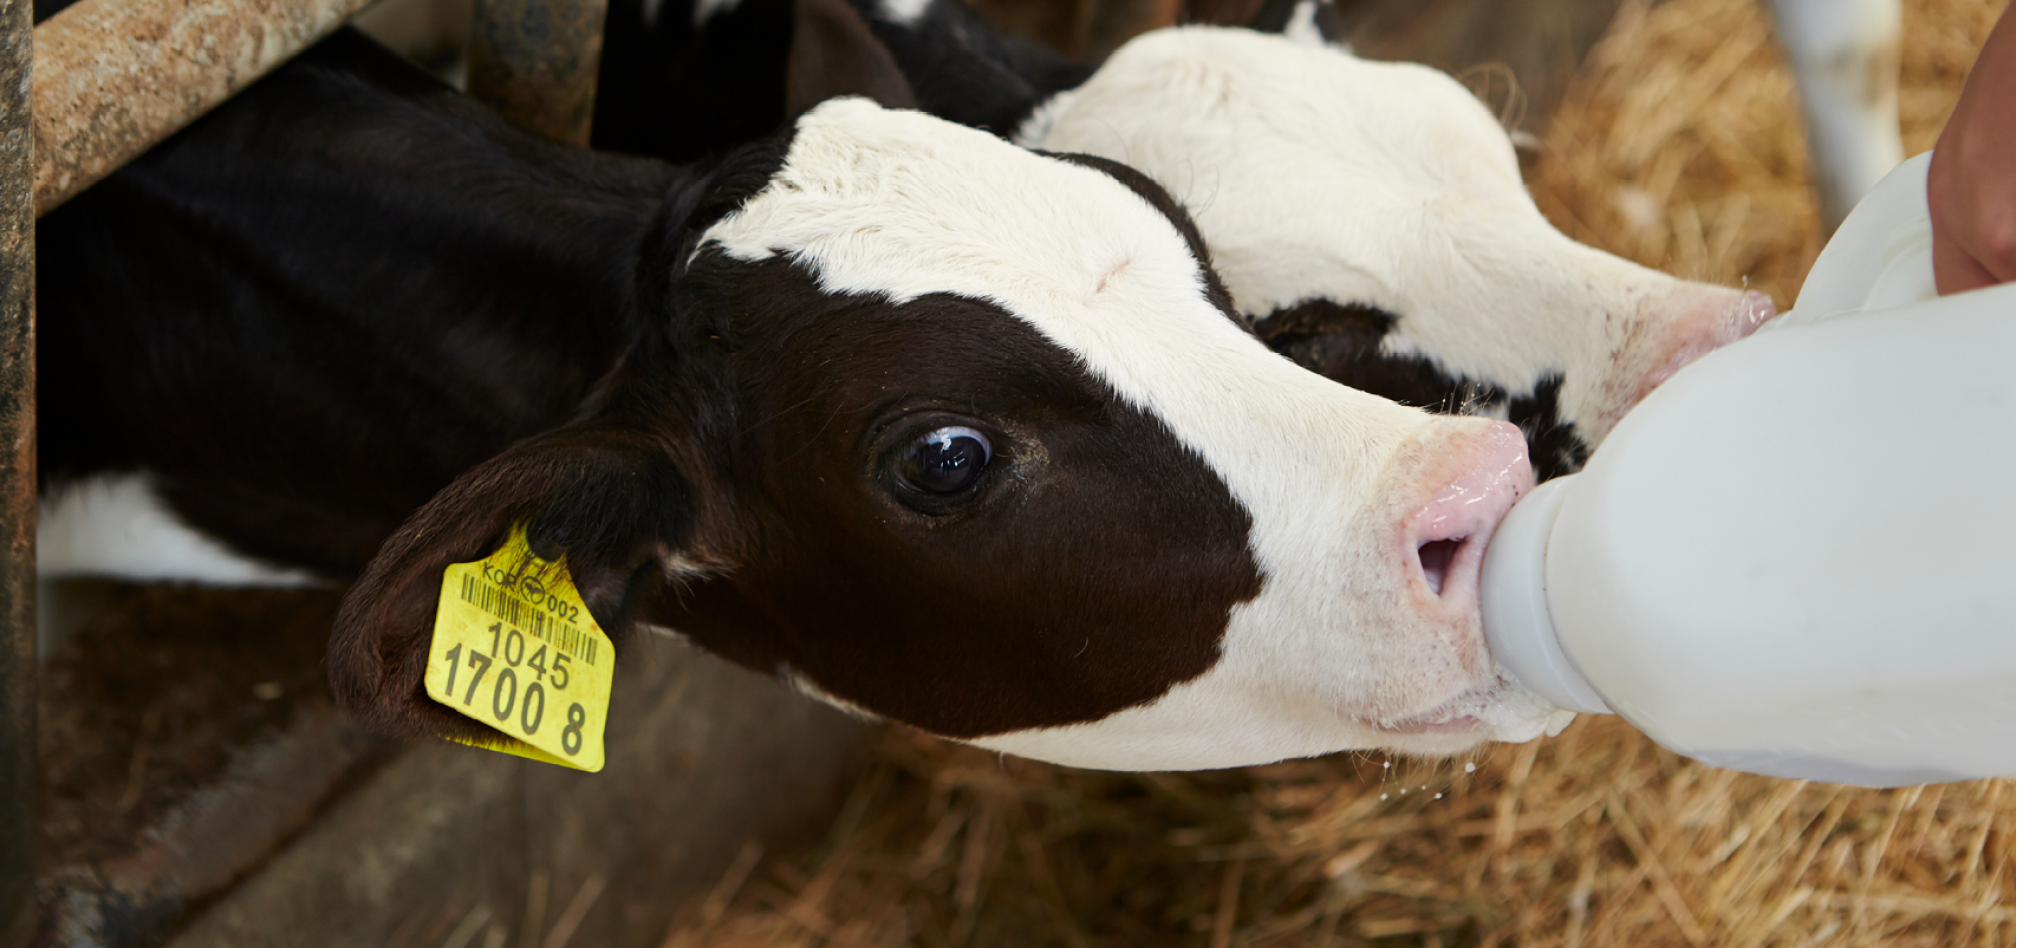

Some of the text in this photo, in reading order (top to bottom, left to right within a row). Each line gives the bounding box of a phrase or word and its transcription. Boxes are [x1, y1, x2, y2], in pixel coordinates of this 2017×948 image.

[482, 562, 579, 624] KOR 002
[488, 622, 571, 690] 1045
[445, 642, 585, 756] 1700 8
